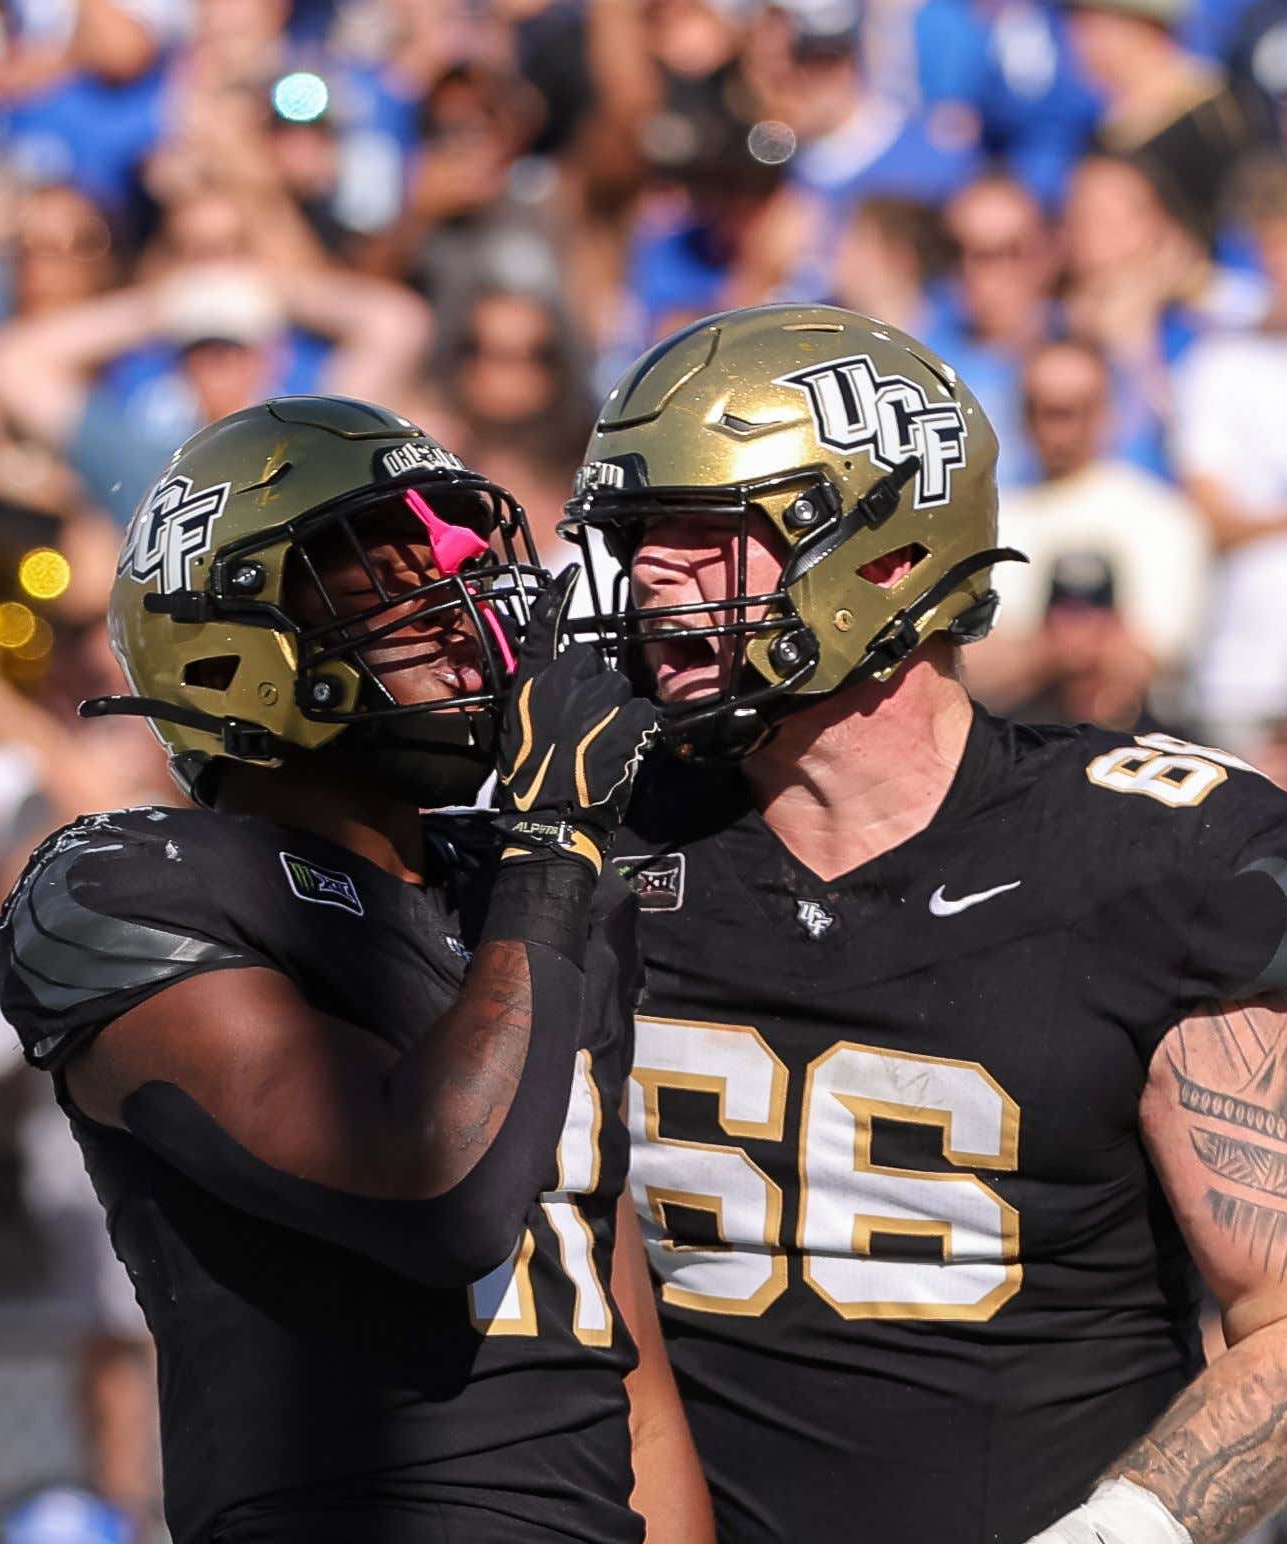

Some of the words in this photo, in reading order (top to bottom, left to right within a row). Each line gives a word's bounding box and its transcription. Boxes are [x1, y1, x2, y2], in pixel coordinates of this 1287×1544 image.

[771, 354, 967, 510] UCF
[797, 900, 834, 938] UCF
[626, 1014, 1023, 1322] 66
